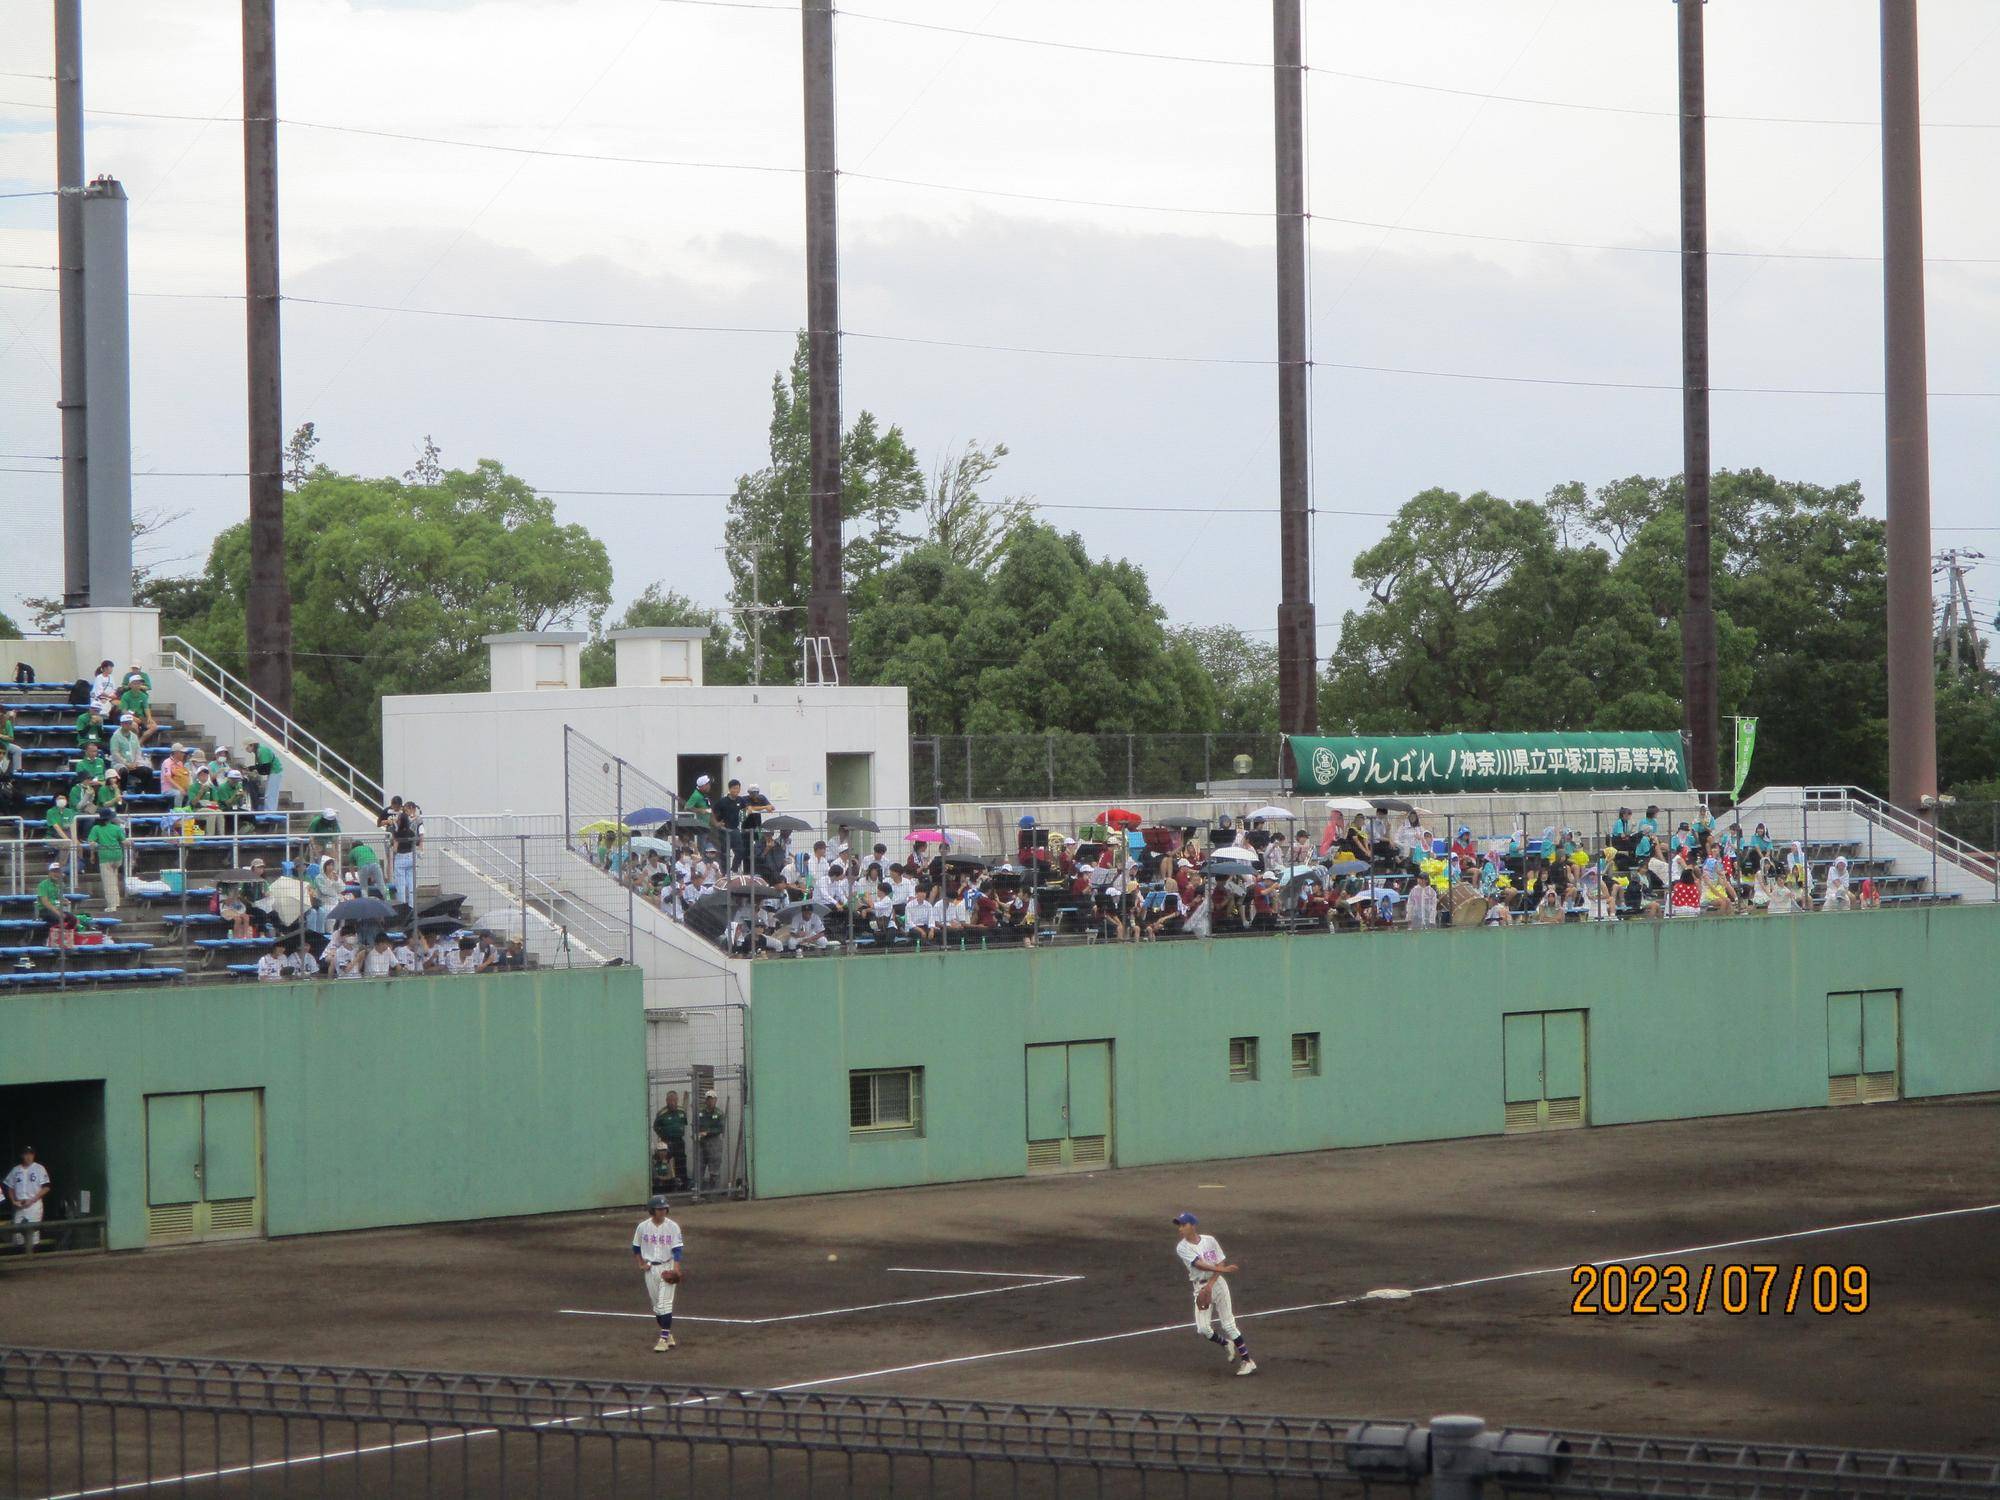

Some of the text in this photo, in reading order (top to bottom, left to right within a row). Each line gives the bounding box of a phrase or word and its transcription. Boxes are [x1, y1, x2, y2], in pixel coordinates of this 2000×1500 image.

[1460, 747, 1680, 777] 神奈川県立平塚江南高等学校
